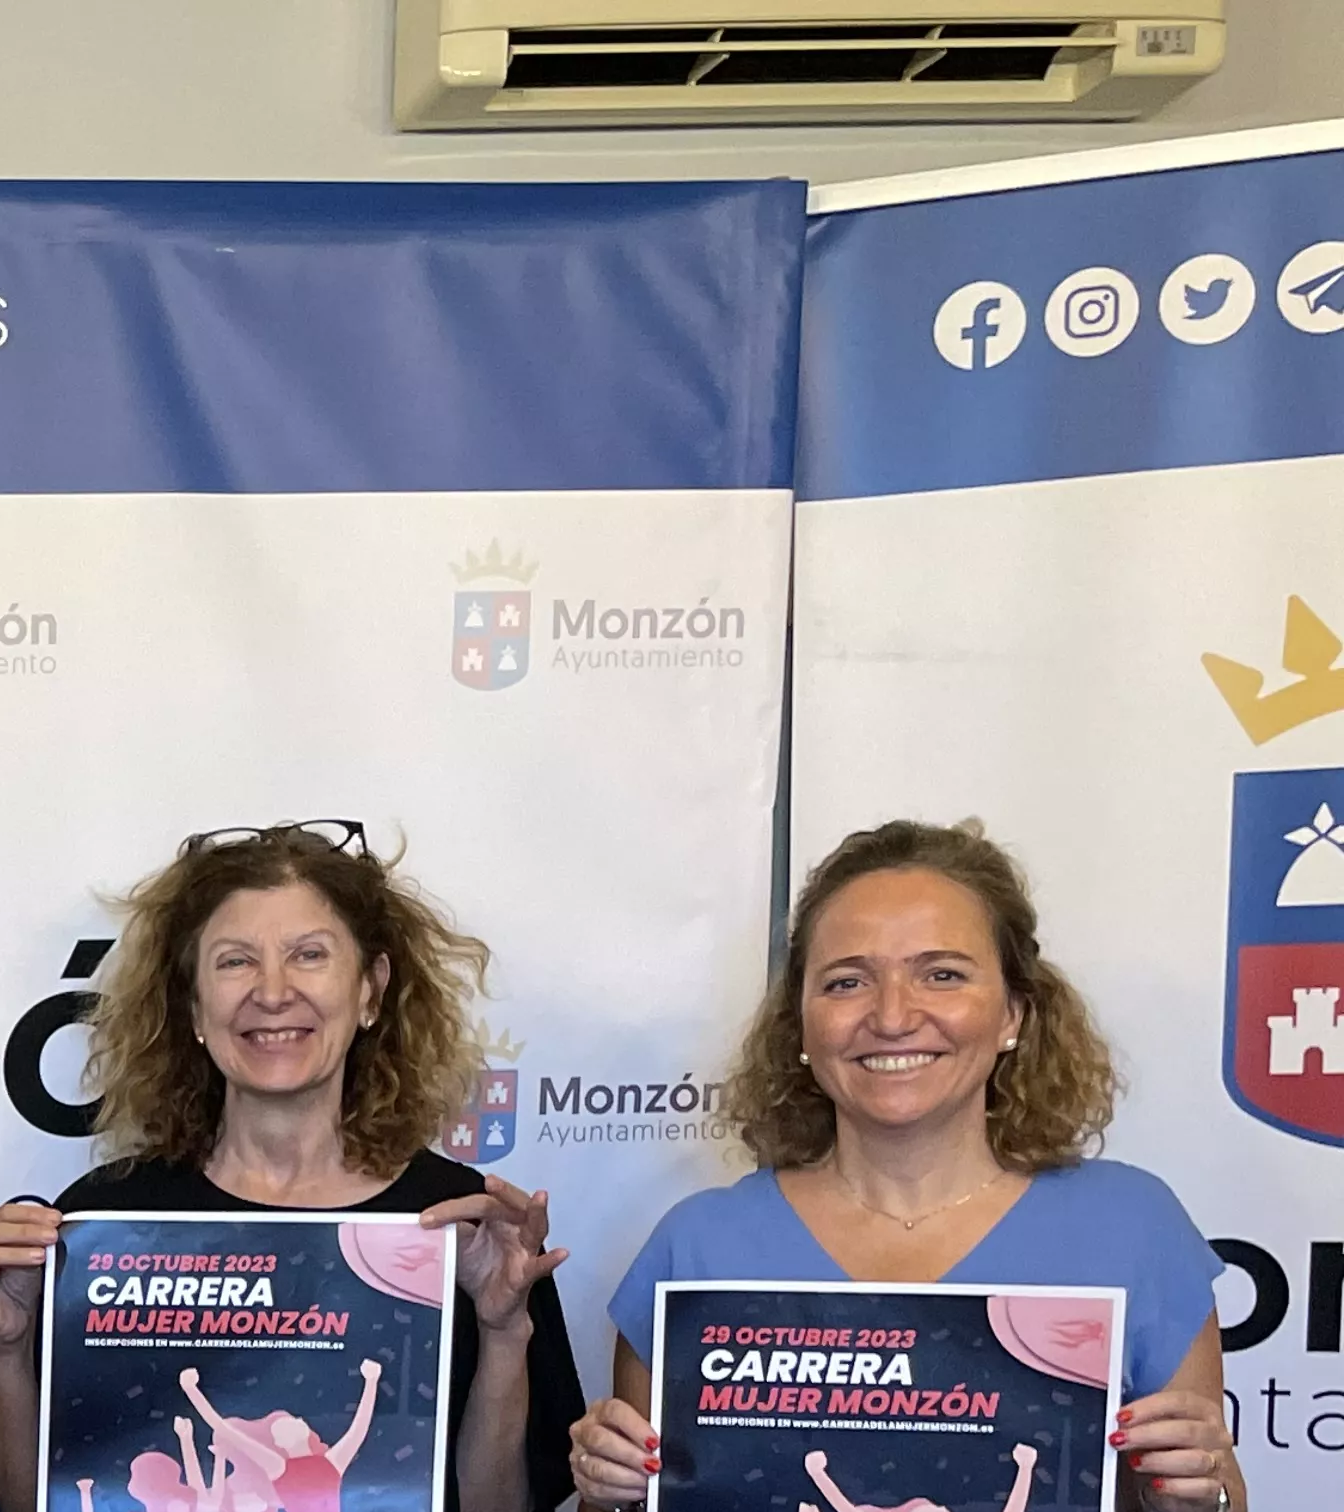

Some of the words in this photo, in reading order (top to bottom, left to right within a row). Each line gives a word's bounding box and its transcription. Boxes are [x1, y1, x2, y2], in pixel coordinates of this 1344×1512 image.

[552, 594, 745, 639] Monzón
[552, 644, 744, 672] Ayuntamiento
[537, 1120, 727, 1147] Ayuntamiento
[87, 1254, 113, 1271] 29
[118, 1254, 221, 1272] OCTUBRE
[224, 1255, 277, 1272] 2023
[87, 1276, 274, 1307] CARRERA
[86, 1309, 195, 1334] MUJER
[200, 1304, 350, 1336] MONZÓN
[85, 1339, 153, 1347] INSCRIPCIONES
[156, 1339, 167, 1347] EN
[701, 1325, 730, 1344] 29
[735, 1327, 852, 1347] OCTUBRE
[855, 1329, 917, 1349] 2023
[700, 1349, 913, 1385] CARRERA
[698, 1385, 823, 1414] MUJER
[827, 1383, 1000, 1418] MONZÓN
[697, 1416, 775, 1427] INSCRIPCIONES
[777, 1418, 791, 1428] EN
